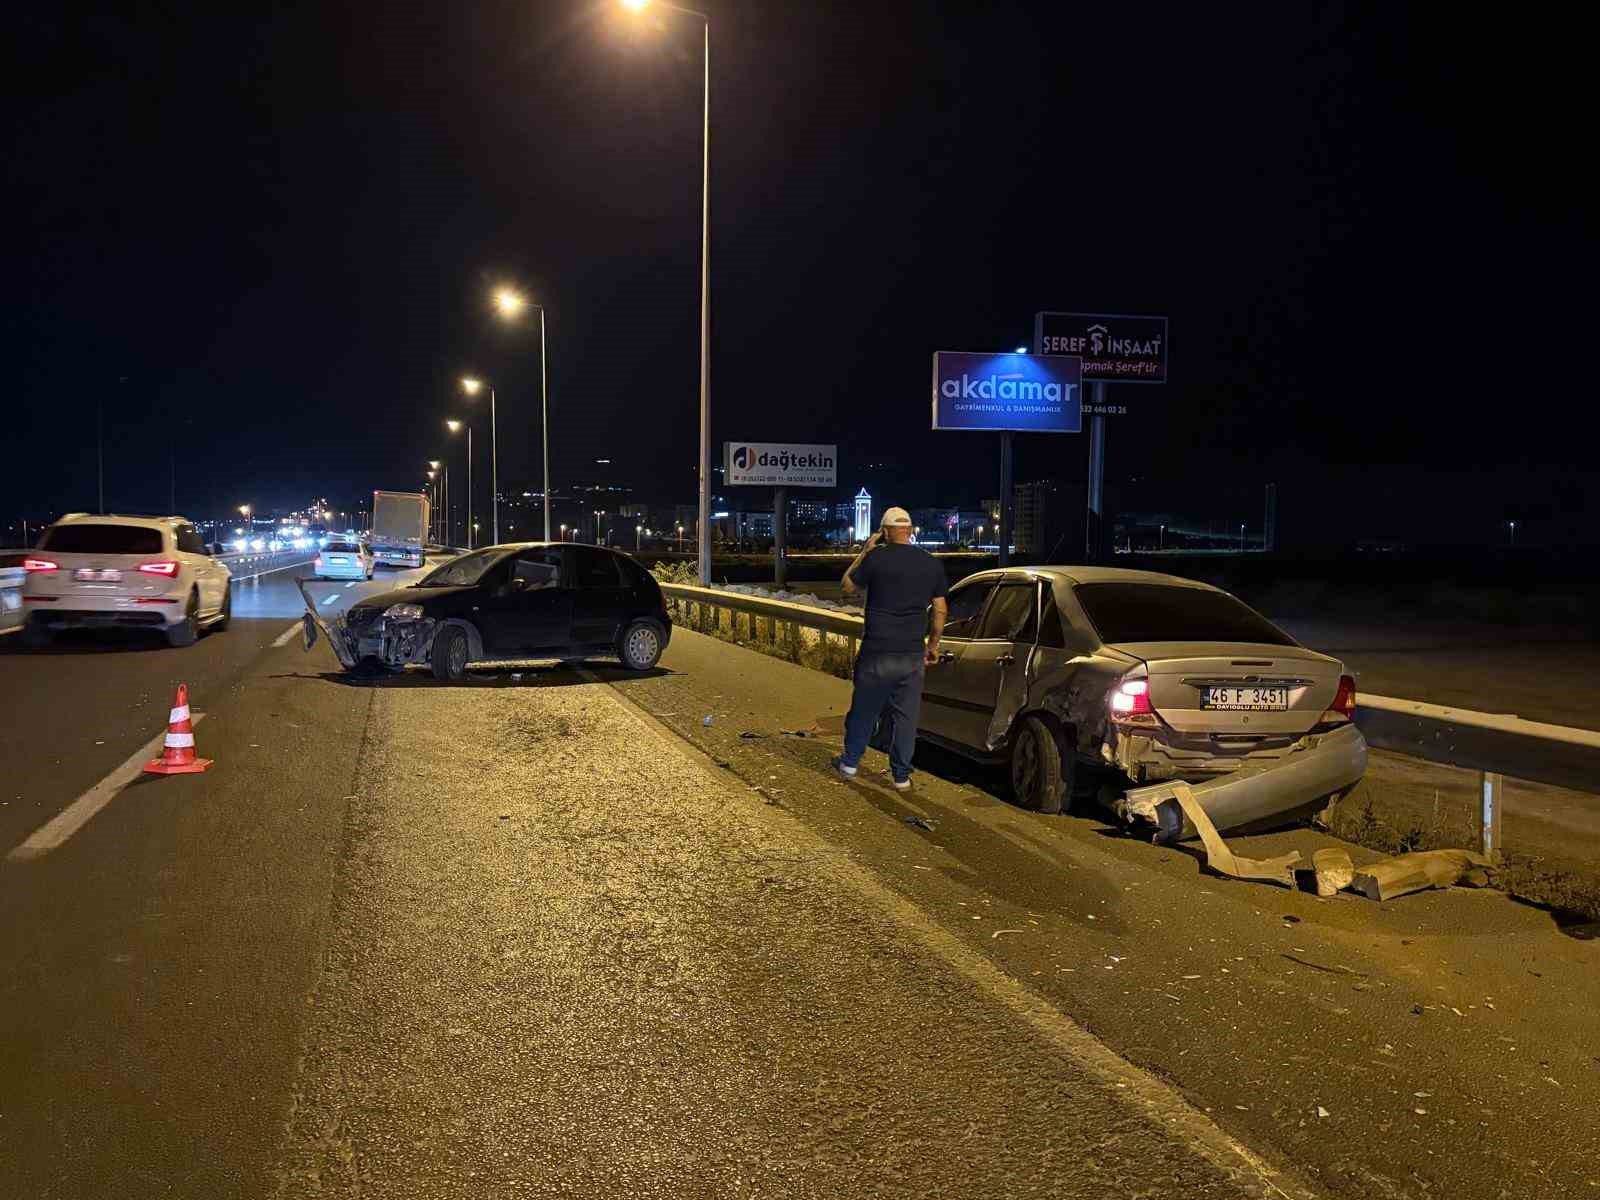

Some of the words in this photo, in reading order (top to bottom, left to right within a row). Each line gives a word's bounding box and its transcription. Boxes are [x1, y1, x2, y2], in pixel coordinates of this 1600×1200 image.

[1043, 336, 1086, 353] ŞEREF
[1107, 335, 1161, 356] İNŞAAT
[941, 373, 1079, 402] akdamar
[758, 450, 833, 471] dağtekin
[1211, 688, 1228, 703] 46
[1236, 688, 1243, 703] F
[1252, 688, 1284, 703] 3451
